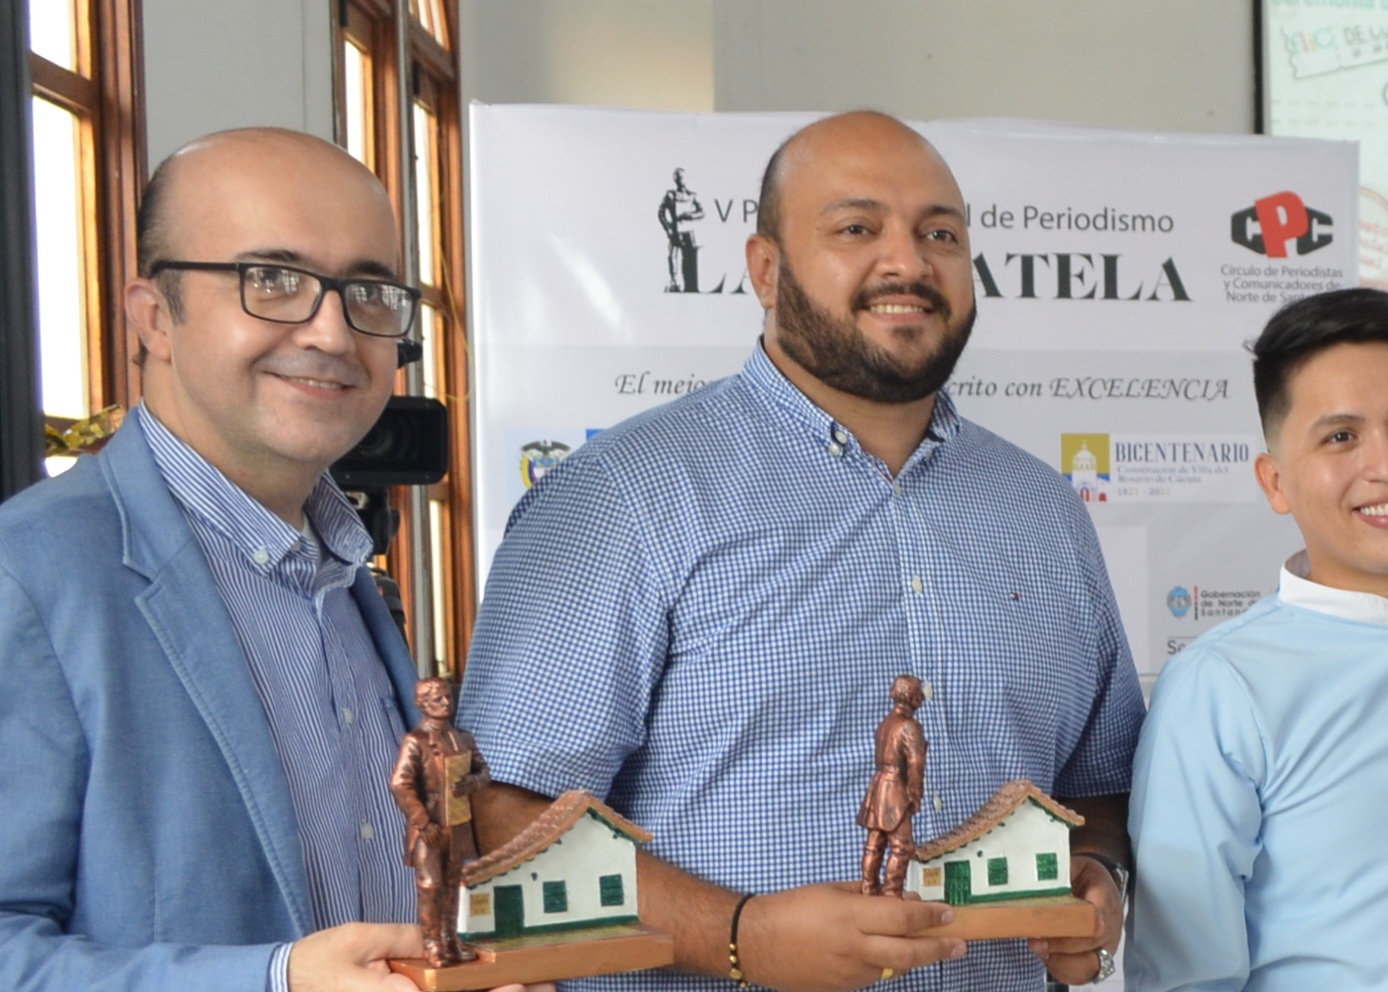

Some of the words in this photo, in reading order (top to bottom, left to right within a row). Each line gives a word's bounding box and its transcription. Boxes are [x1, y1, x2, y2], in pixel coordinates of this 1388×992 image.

[714, 199, 733, 223] V
[981, 203, 1015, 229] de
[1023, 205, 1174, 232] Periodismo
[1231, 190, 1334, 258] CPC
[973, 251, 1194, 301] ATELA
[1220, 264, 1261, 277] Círculo
[1264, 265, 1279, 277] de
[1281, 266, 1343, 278] Periodistas
[1224, 280, 1230, 291] y
[1232, 277, 1323, 290] Comunicadores
[1326, 280, 1341, 290] de
[1226, 291, 1260, 302] Norte
[1264, 291, 1278, 302] de
[615, 371, 651, 395] El
[654, 373, 706, 395] mejo
[1005, 380, 1042, 397] con
[1050, 377, 1229, 400] EXCELENCIA
[1115, 442, 1250, 463] BICENTENARIO
